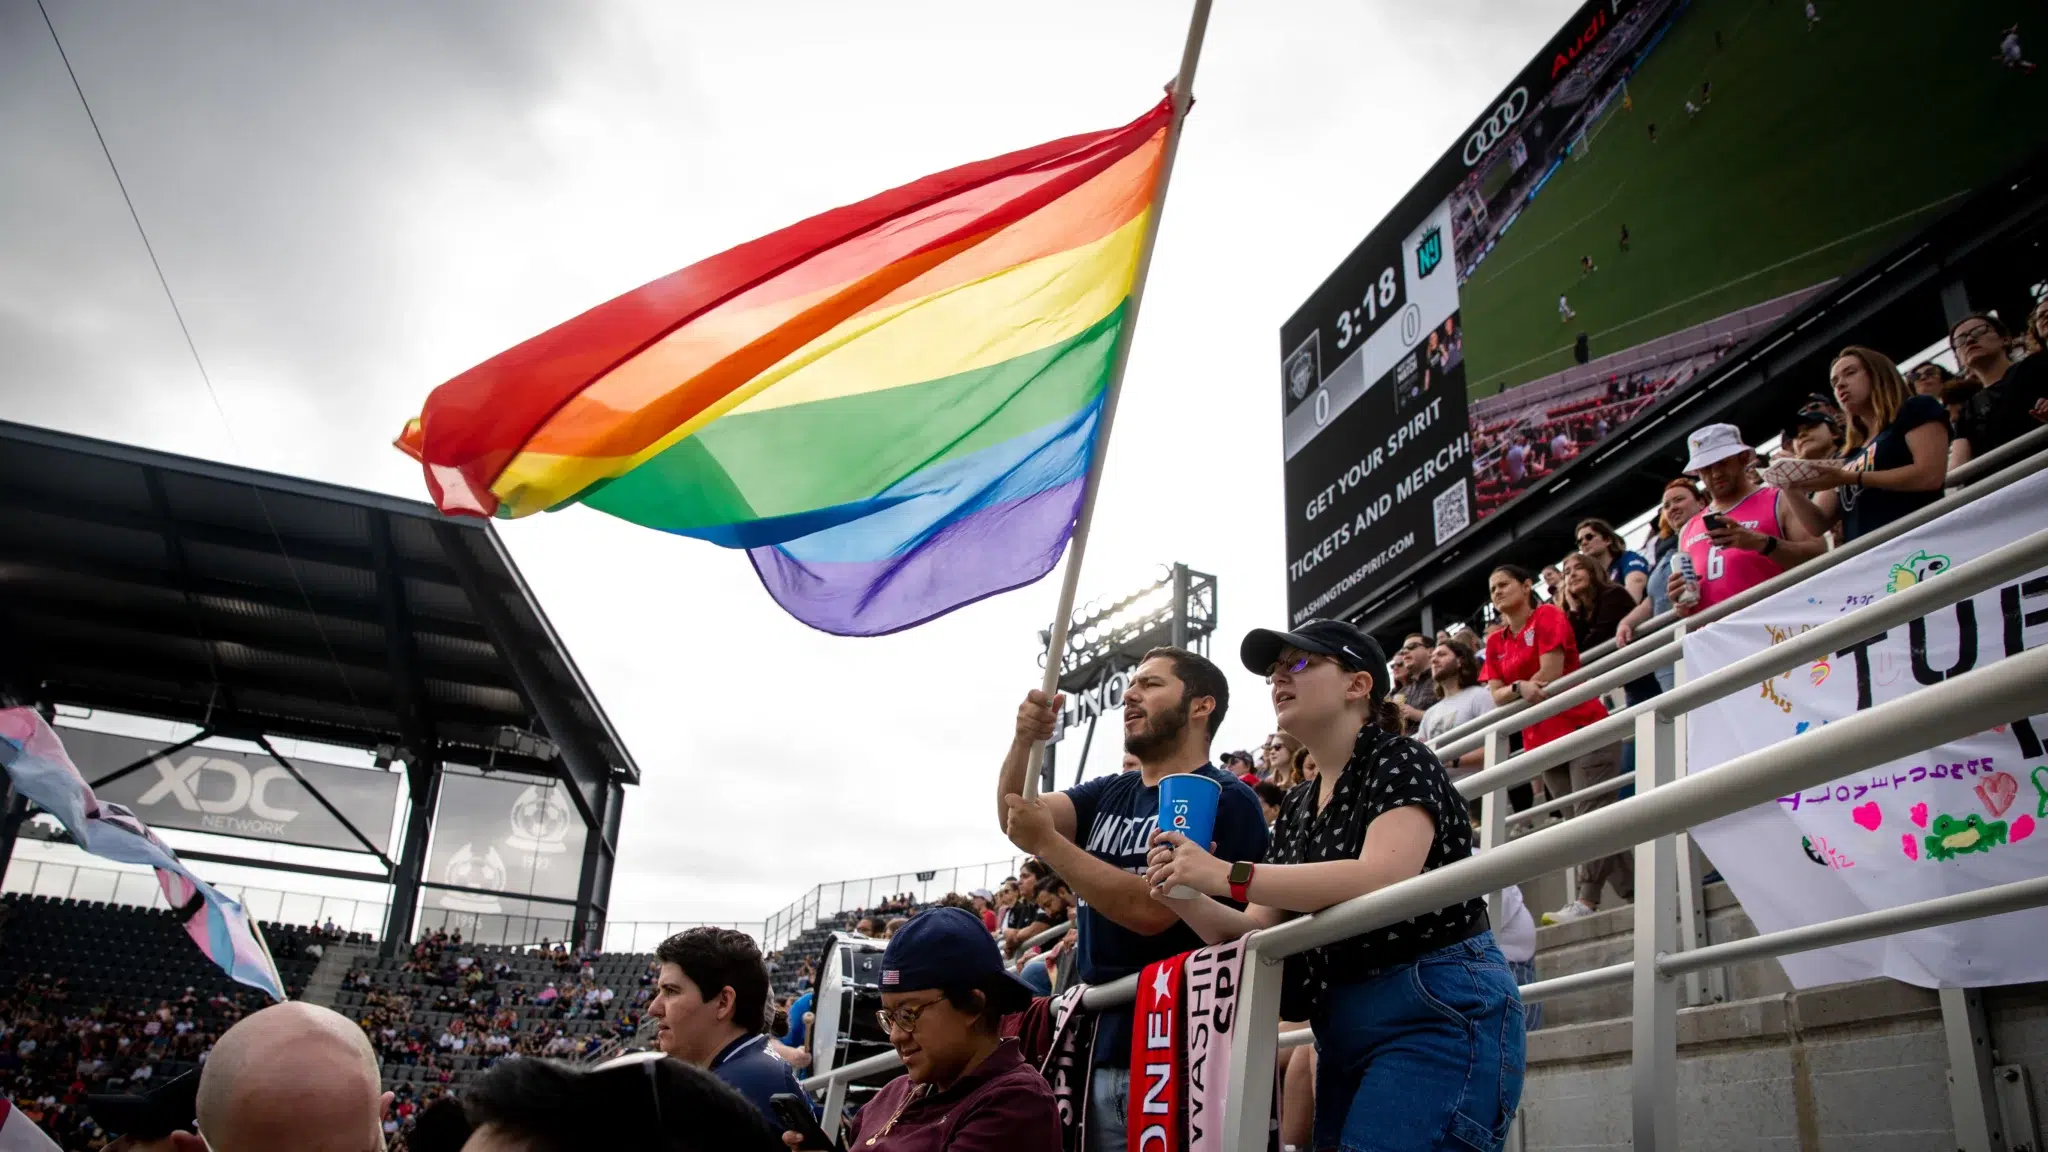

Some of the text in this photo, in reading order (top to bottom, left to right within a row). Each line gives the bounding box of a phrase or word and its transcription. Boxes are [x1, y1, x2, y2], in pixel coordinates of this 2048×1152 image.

[1551, 9, 1605, 80] Audi
[1419, 232, 1440, 275] NY
[1336, 266, 1396, 349] 3:18
[1401, 303, 1421, 347] 0
[1314, 388, 1330, 427] 0
[1305, 396, 1443, 521] GET YOUR SPIRIT
[1289, 431, 1470, 583] TICKETS AND MERCH!
[1293, 531, 1415, 625] WASHINGTONSPIRIT.COM
[1707, 545, 1725, 581] 6
[1073, 665, 1136, 728] INO
[137, 750, 303, 823] XDC
[202, 814, 287, 837] NETWORK
